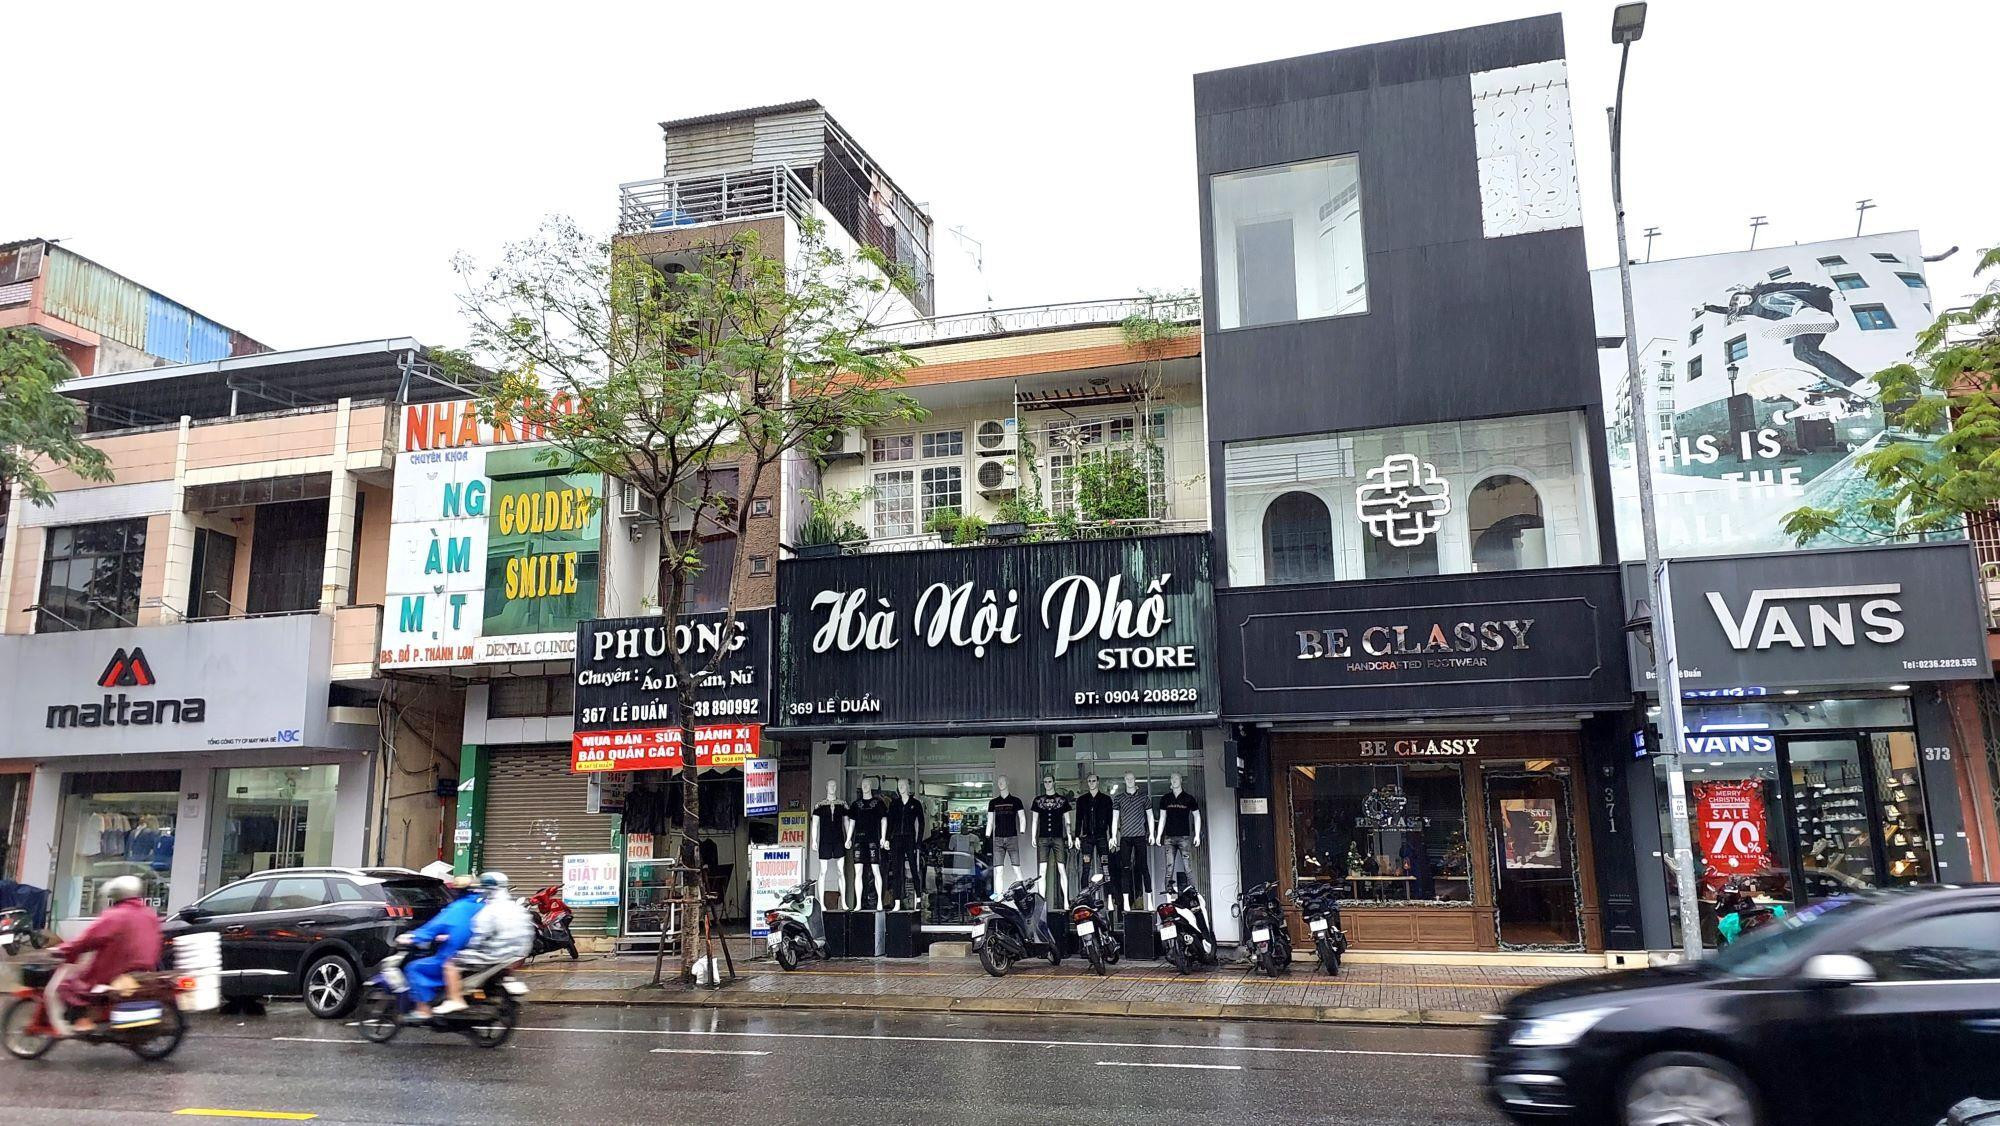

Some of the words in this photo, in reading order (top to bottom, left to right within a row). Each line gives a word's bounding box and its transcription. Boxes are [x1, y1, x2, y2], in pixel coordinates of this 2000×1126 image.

[1740, 428, 1782, 460] IS
[445, 450, 468, 462] KHOA
[1721, 466, 1805, 502] THE
[499, 487, 594, 536] GOLDEN
[505, 552, 578, 600] SMILE
[810, 588, 899, 653] Hà
[914, 581, 1021, 658] Nội
[1041, 573, 1172, 658] Phố
[1705, 583, 1905, 650] VANS
[485, 642, 532, 657] DENTAL
[534, 639, 576, 654] CLINIC
[1295, 627, 1352, 660] BE
[1362, 618, 1535, 657] CLASSY
[1097, 645, 1196, 670] STORE
[1427, 657, 1488, 669] FOOTWEAR
[641, 667, 662, 690] Áo
[789, 702, 813, 715] 369
[817, 698, 836, 714] LÊ
[840, 692, 880, 712] DUẨN
[1074, 691, 1100, 705] ĐT:
[1104, 689, 1139, 704] 0904
[1143, 688, 1197, 702] 208828
[46, 693, 206, 729] mattana
[582, 707, 607, 723] 367
[613, 702, 629, 722] LÊ
[631, 697, 668, 721] DUẨN
[712, 698, 759, 715] 890992
[582, 735, 611, 747] MUA
[614, 732, 643, 746] BÁN
[694, 727, 732, 742] ĐÁNH
[735, 727, 750, 739] XI
[1359, 740, 1387, 757] BE
[1394, 738, 1480, 756] CLASSY
[648, 744, 675, 758] CÁC
[711, 742, 731, 754] ÁO
[734, 743, 752, 754] DA
[1925, 747, 1951, 760] 373
[1531, 809, 1552, 817] SALE
[1604, 787, 1618, 833] 371
[1712, 809, 1749, 819] SALE
[628, 845, 650, 857] HOA
[764, 851, 790, 859] MINH
